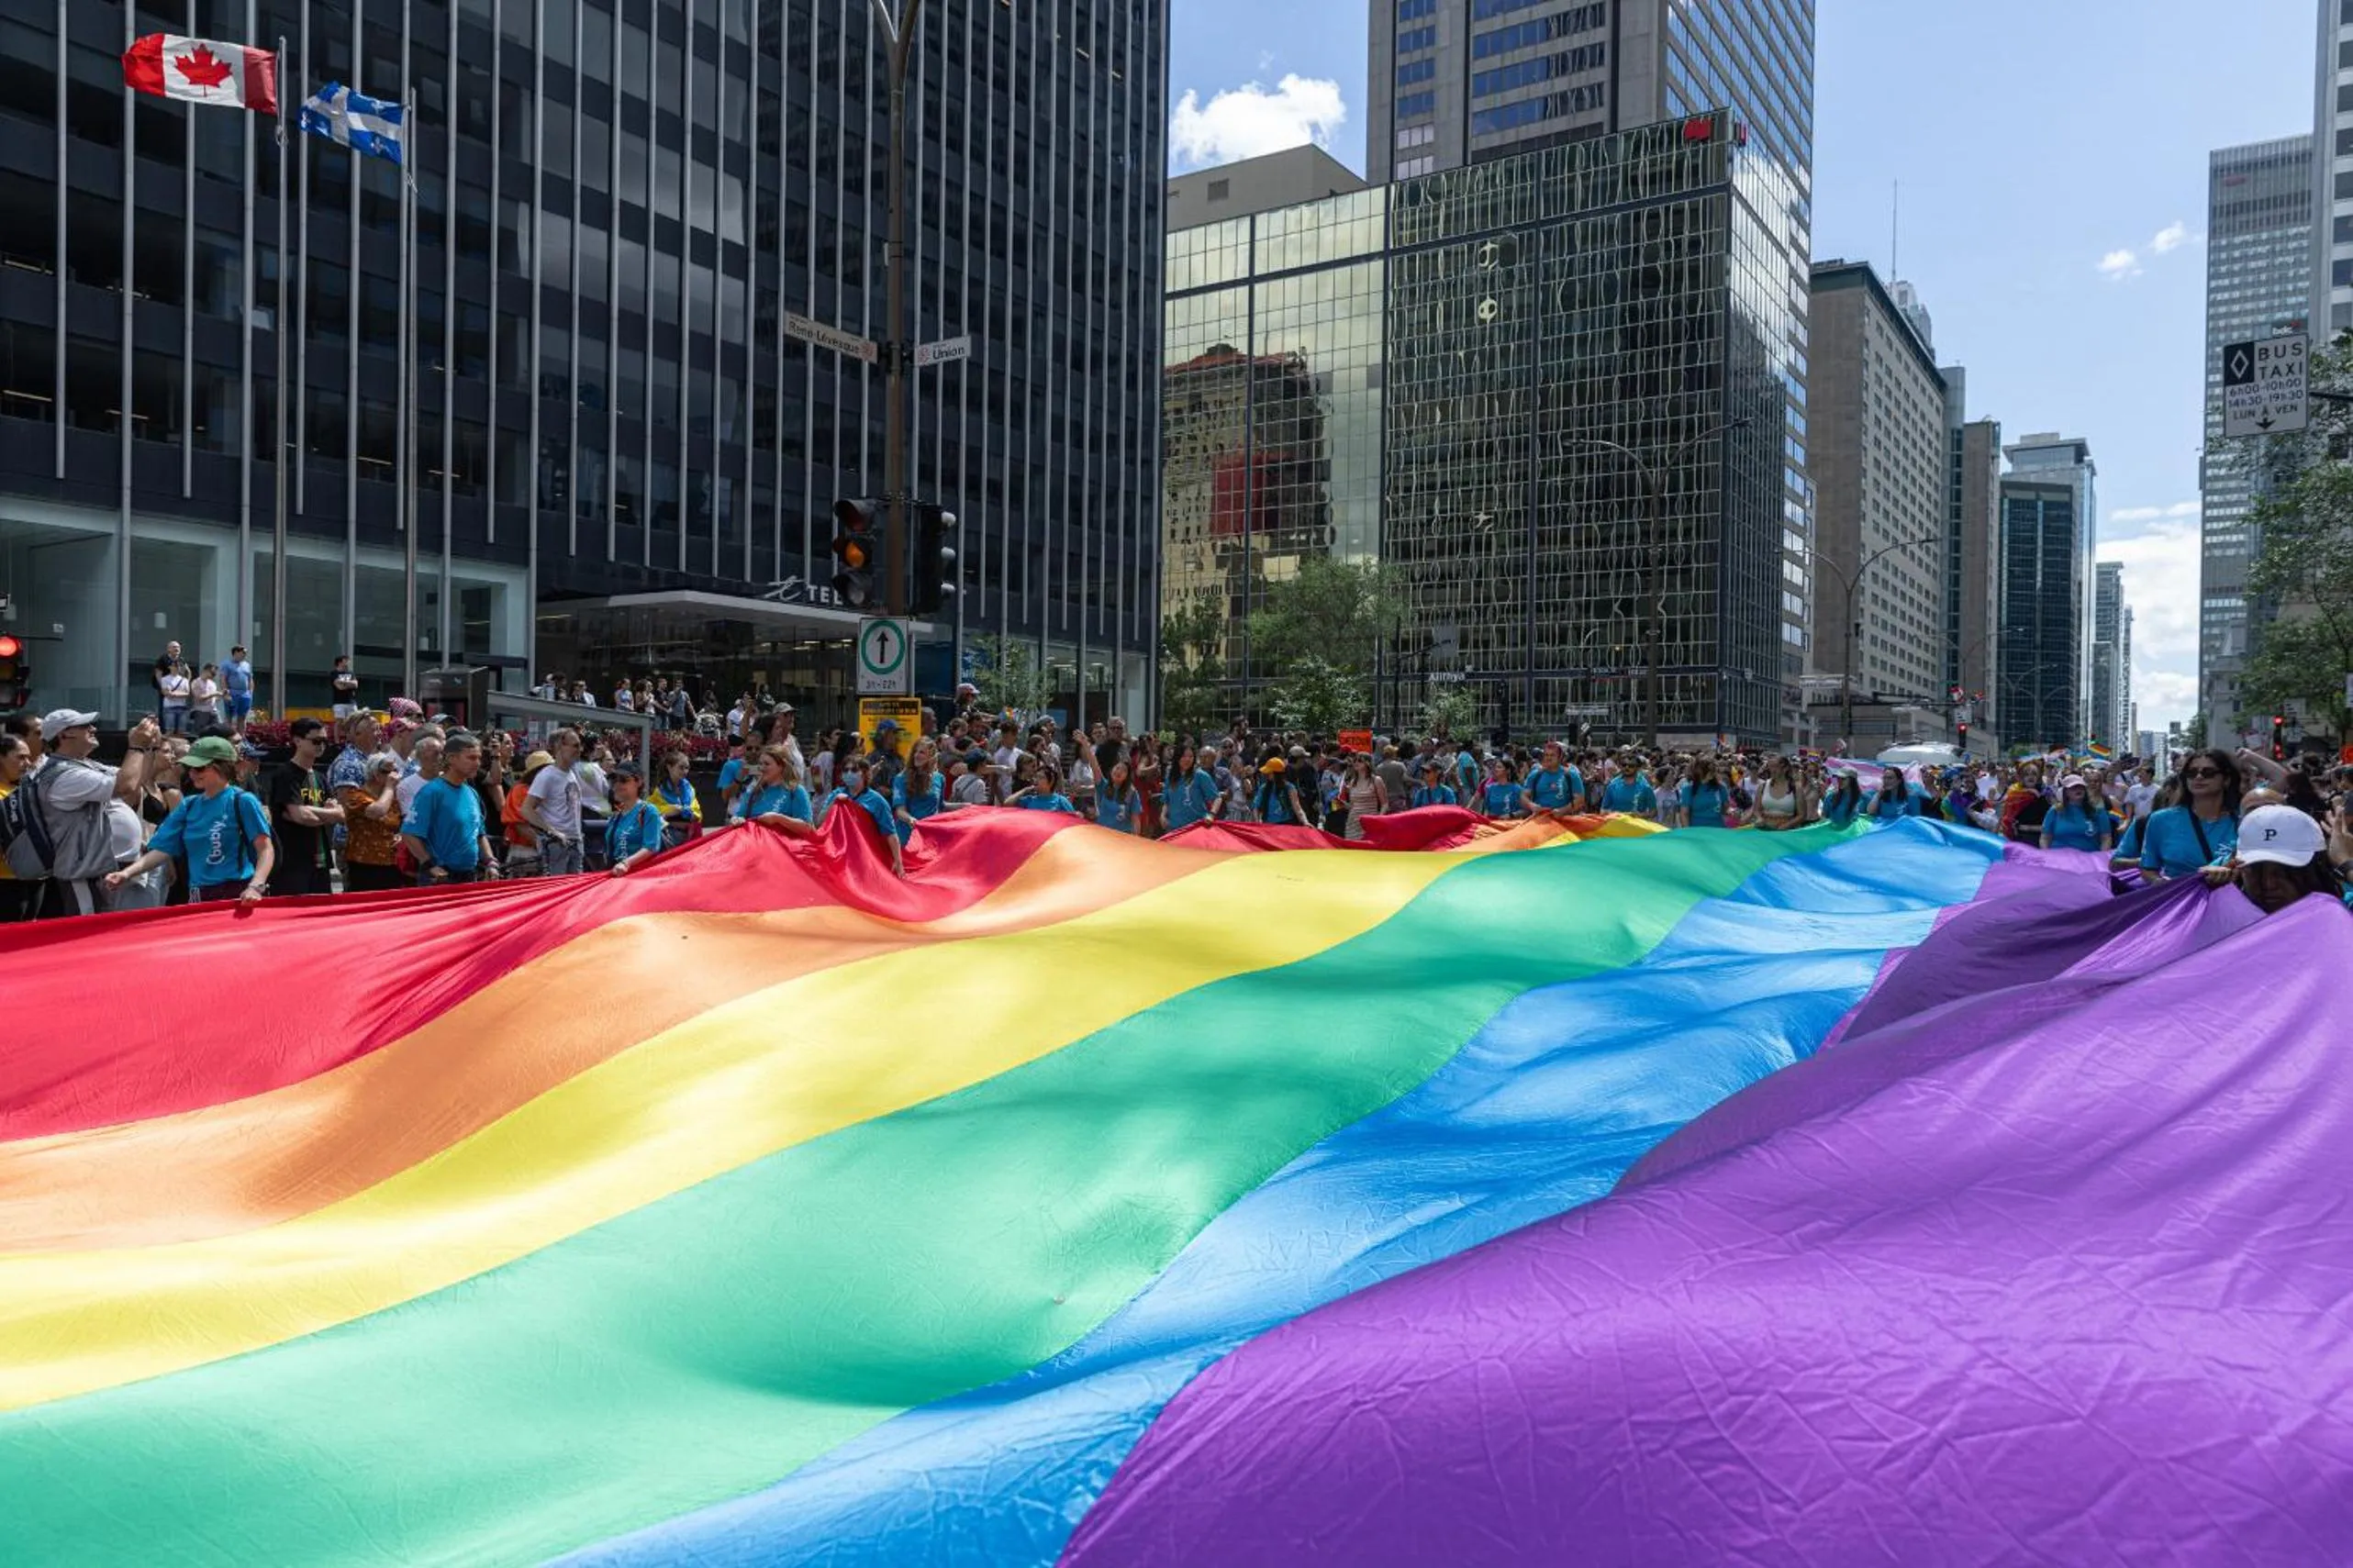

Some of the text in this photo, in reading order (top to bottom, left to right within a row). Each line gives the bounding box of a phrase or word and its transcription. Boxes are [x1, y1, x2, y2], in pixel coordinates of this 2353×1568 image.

[932, 345, 965, 360] Union
[2258, 341, 2303, 361] BUS
[2258, 361, 2303, 380] TAXI
[2233, 410, 2256, 420] LUN
[2275, 404, 2298, 415] VEN
[807, 584, 843, 606] TEL
[2263, 828, 2278, 841] P
